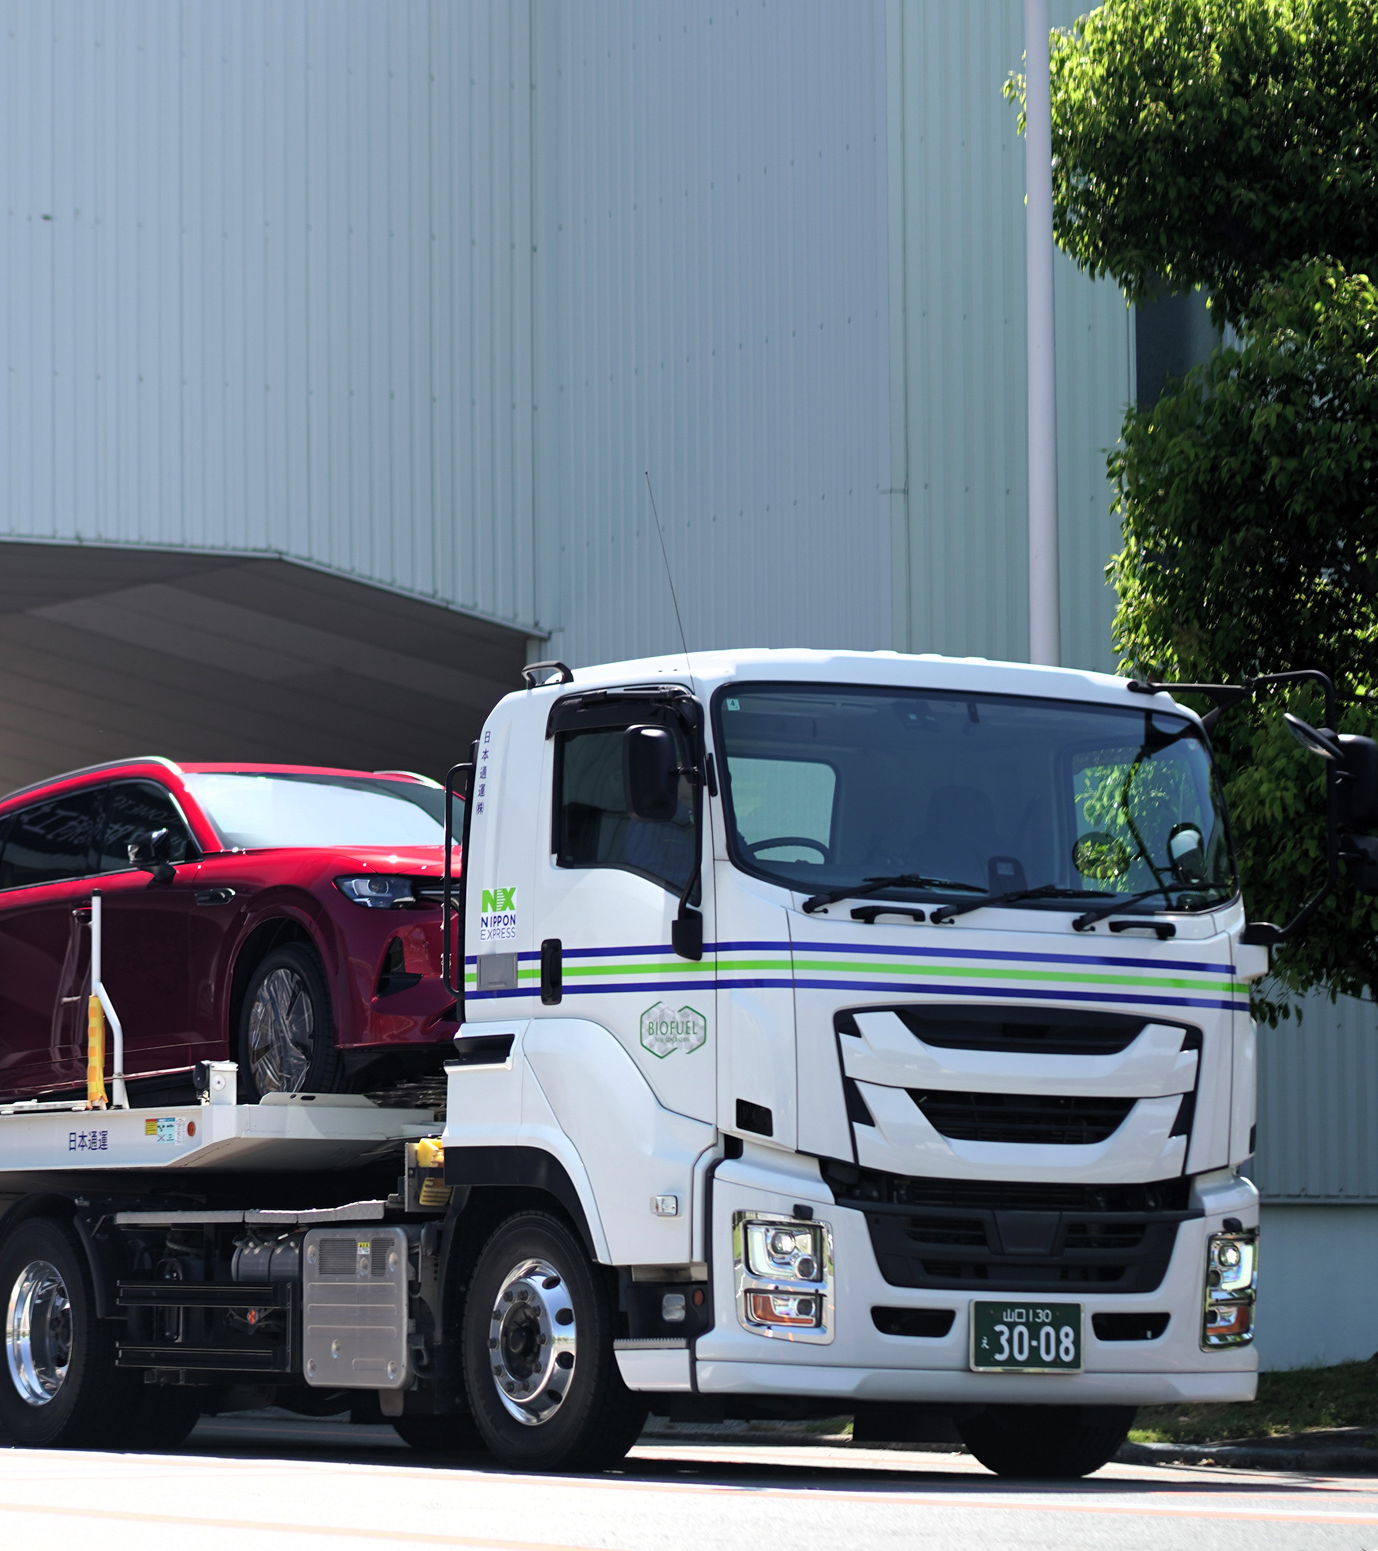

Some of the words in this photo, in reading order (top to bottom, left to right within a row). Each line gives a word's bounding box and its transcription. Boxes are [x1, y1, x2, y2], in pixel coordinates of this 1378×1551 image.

[481, 887, 516, 913] NX
[481, 914, 516, 928] NIPPON
[480, 927, 516, 941] EXPRESS
[648, 1020, 697, 1036] BIOFUEL
[68, 1130, 108, 1151] 日本通運
[994, 1324, 1075, 1362] 30-08
